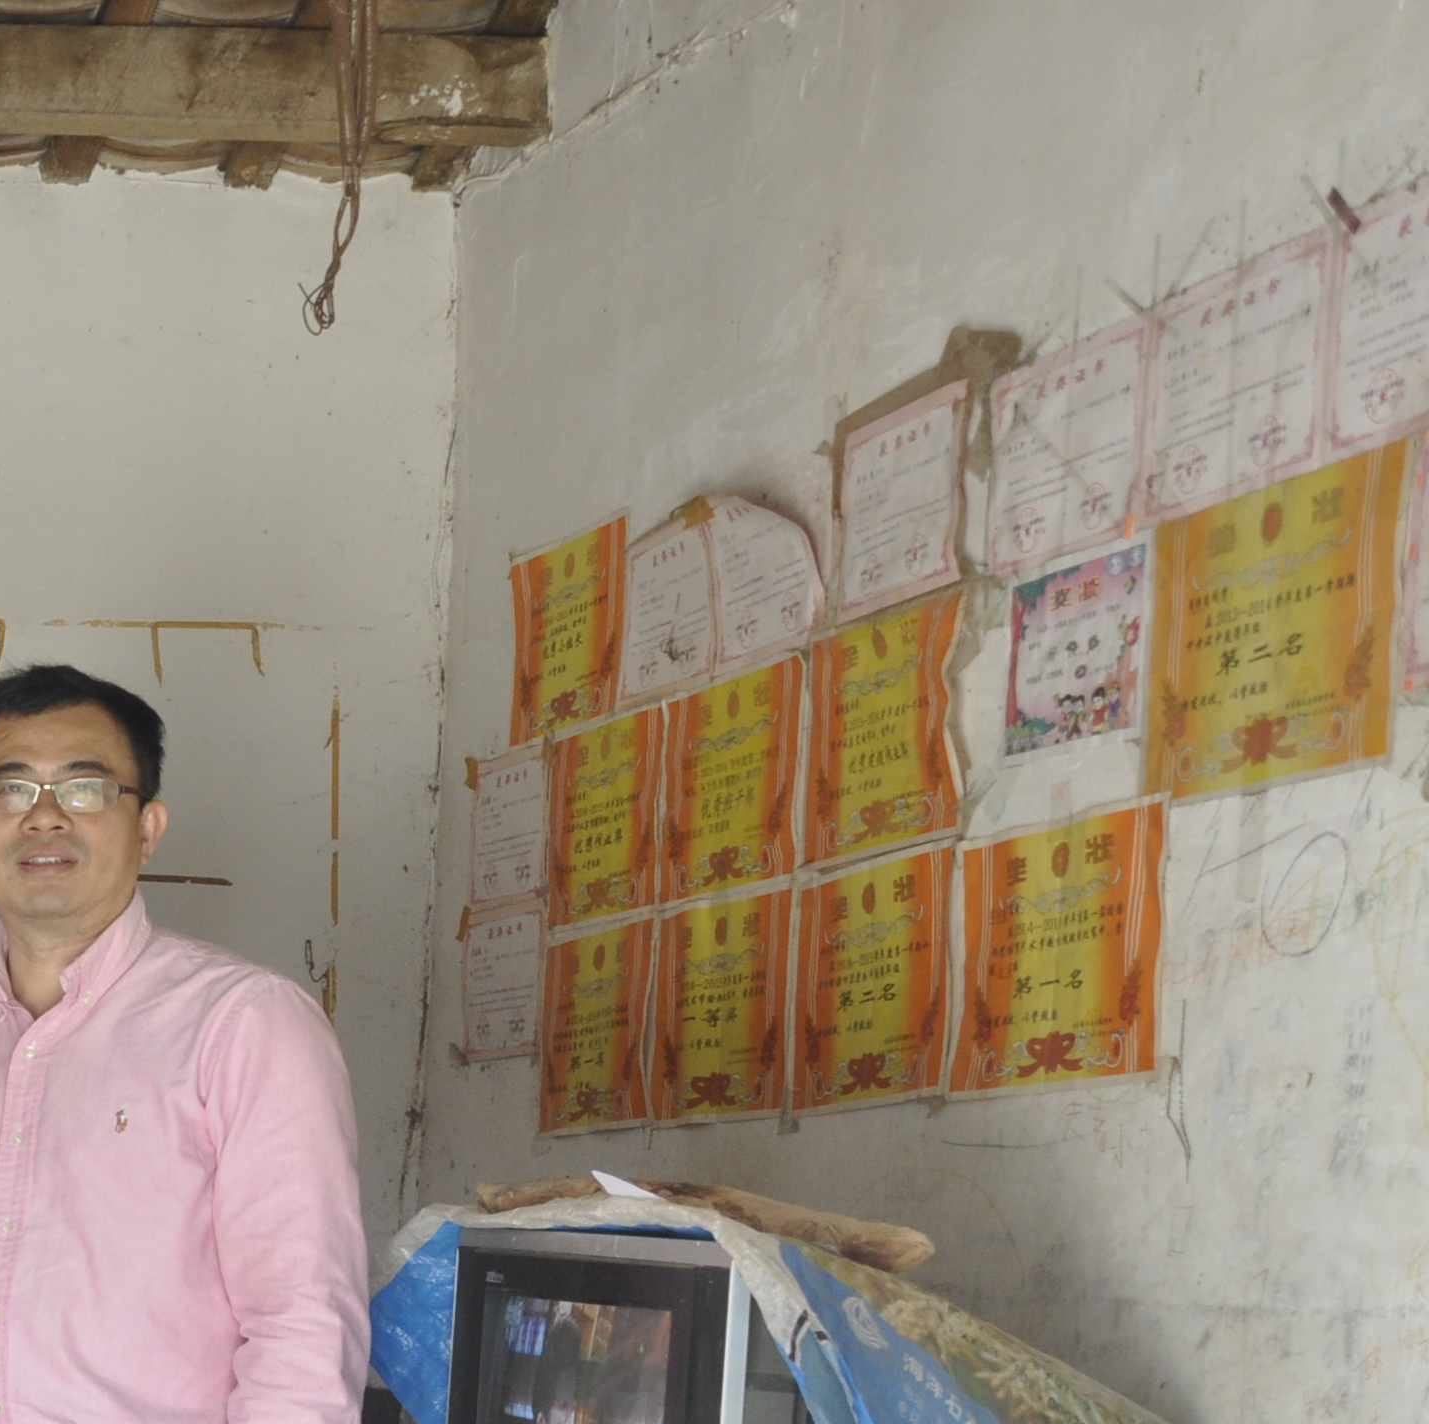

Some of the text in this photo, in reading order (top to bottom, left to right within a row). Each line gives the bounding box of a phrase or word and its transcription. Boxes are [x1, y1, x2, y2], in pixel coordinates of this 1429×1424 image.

[1050, 577, 1101, 611] 奖状
[1215, 630, 1304, 676] 第二名
[837, 979, 897, 1012] 第二名
[1013, 967, 1084, 999] 第一名
